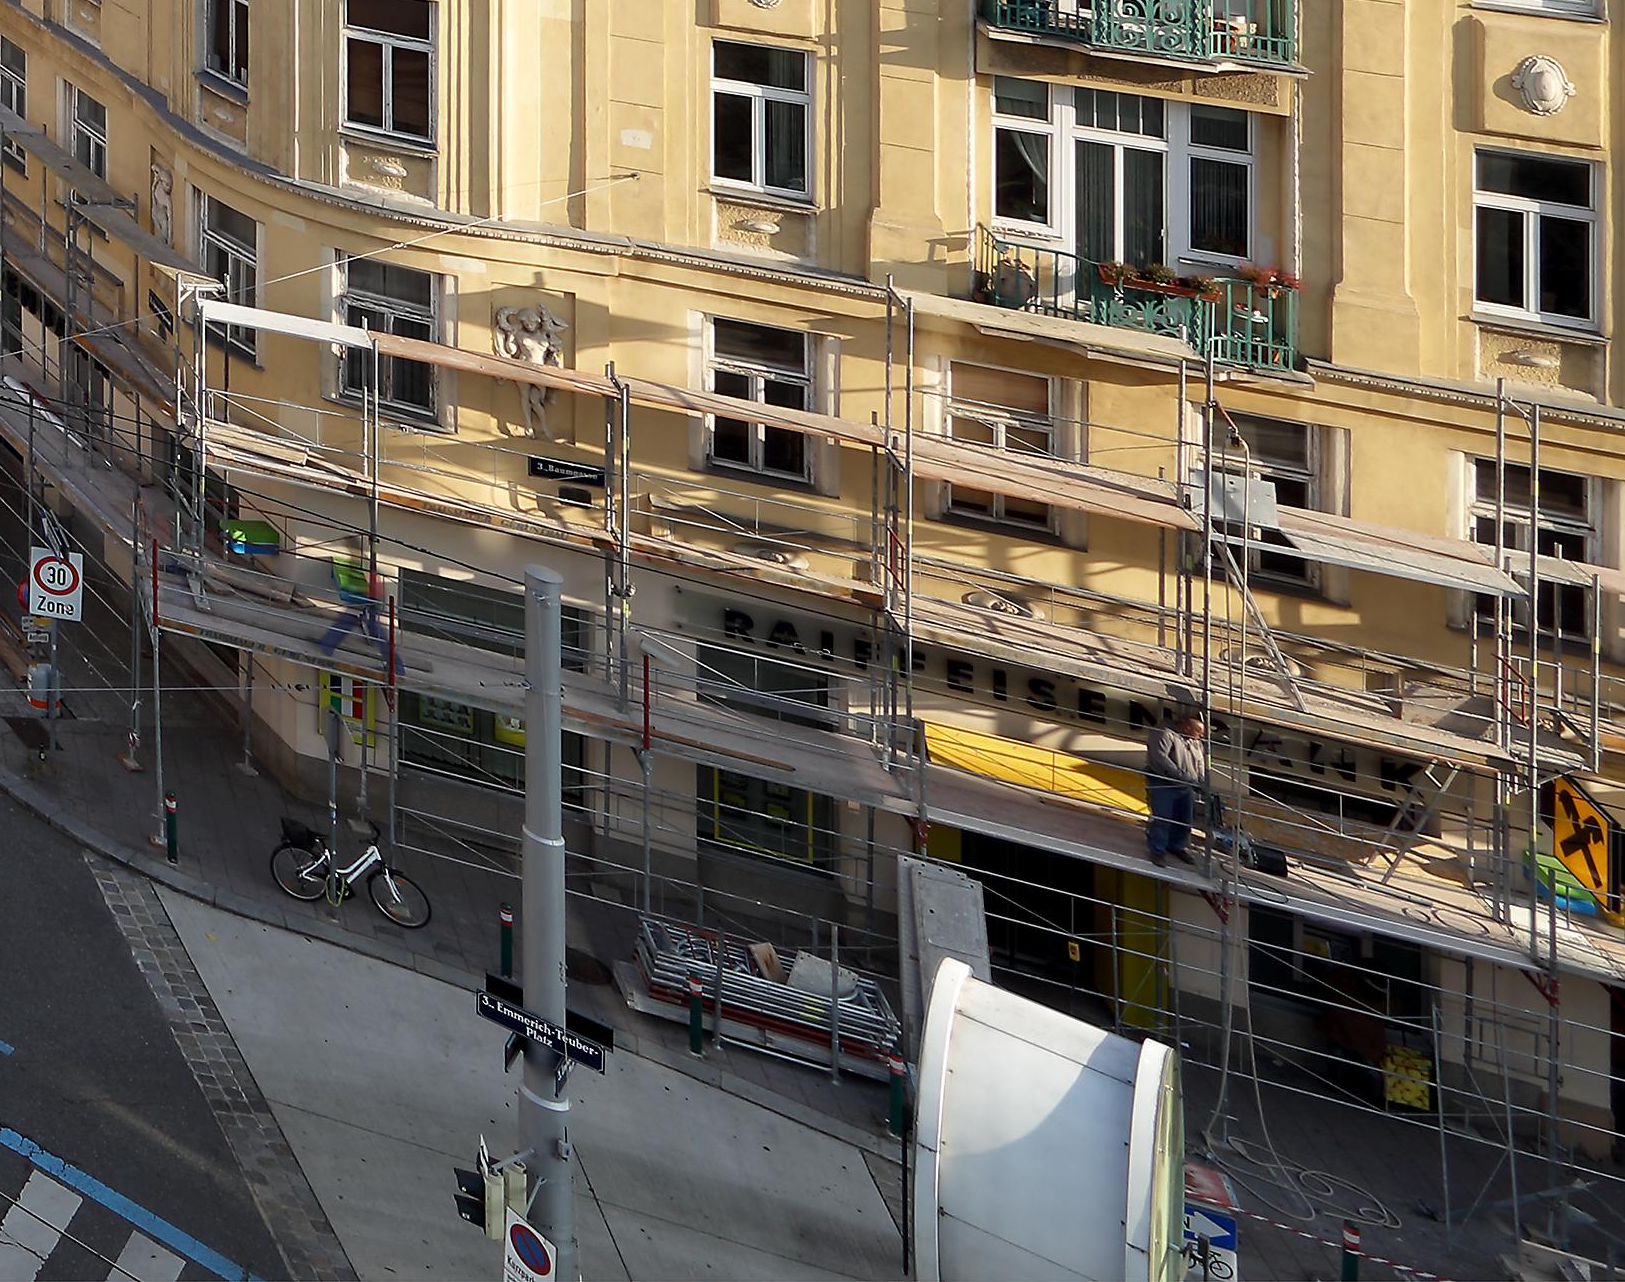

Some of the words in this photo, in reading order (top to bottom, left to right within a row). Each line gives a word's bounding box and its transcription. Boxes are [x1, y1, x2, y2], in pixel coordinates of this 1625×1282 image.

[46, 566, 66, 586] 30
[37, 595, 74, 616] Zone
[496, 1001, 599, 1056] Emmerich-Teuber-
[526, 1026, 553, 1048] Platz
